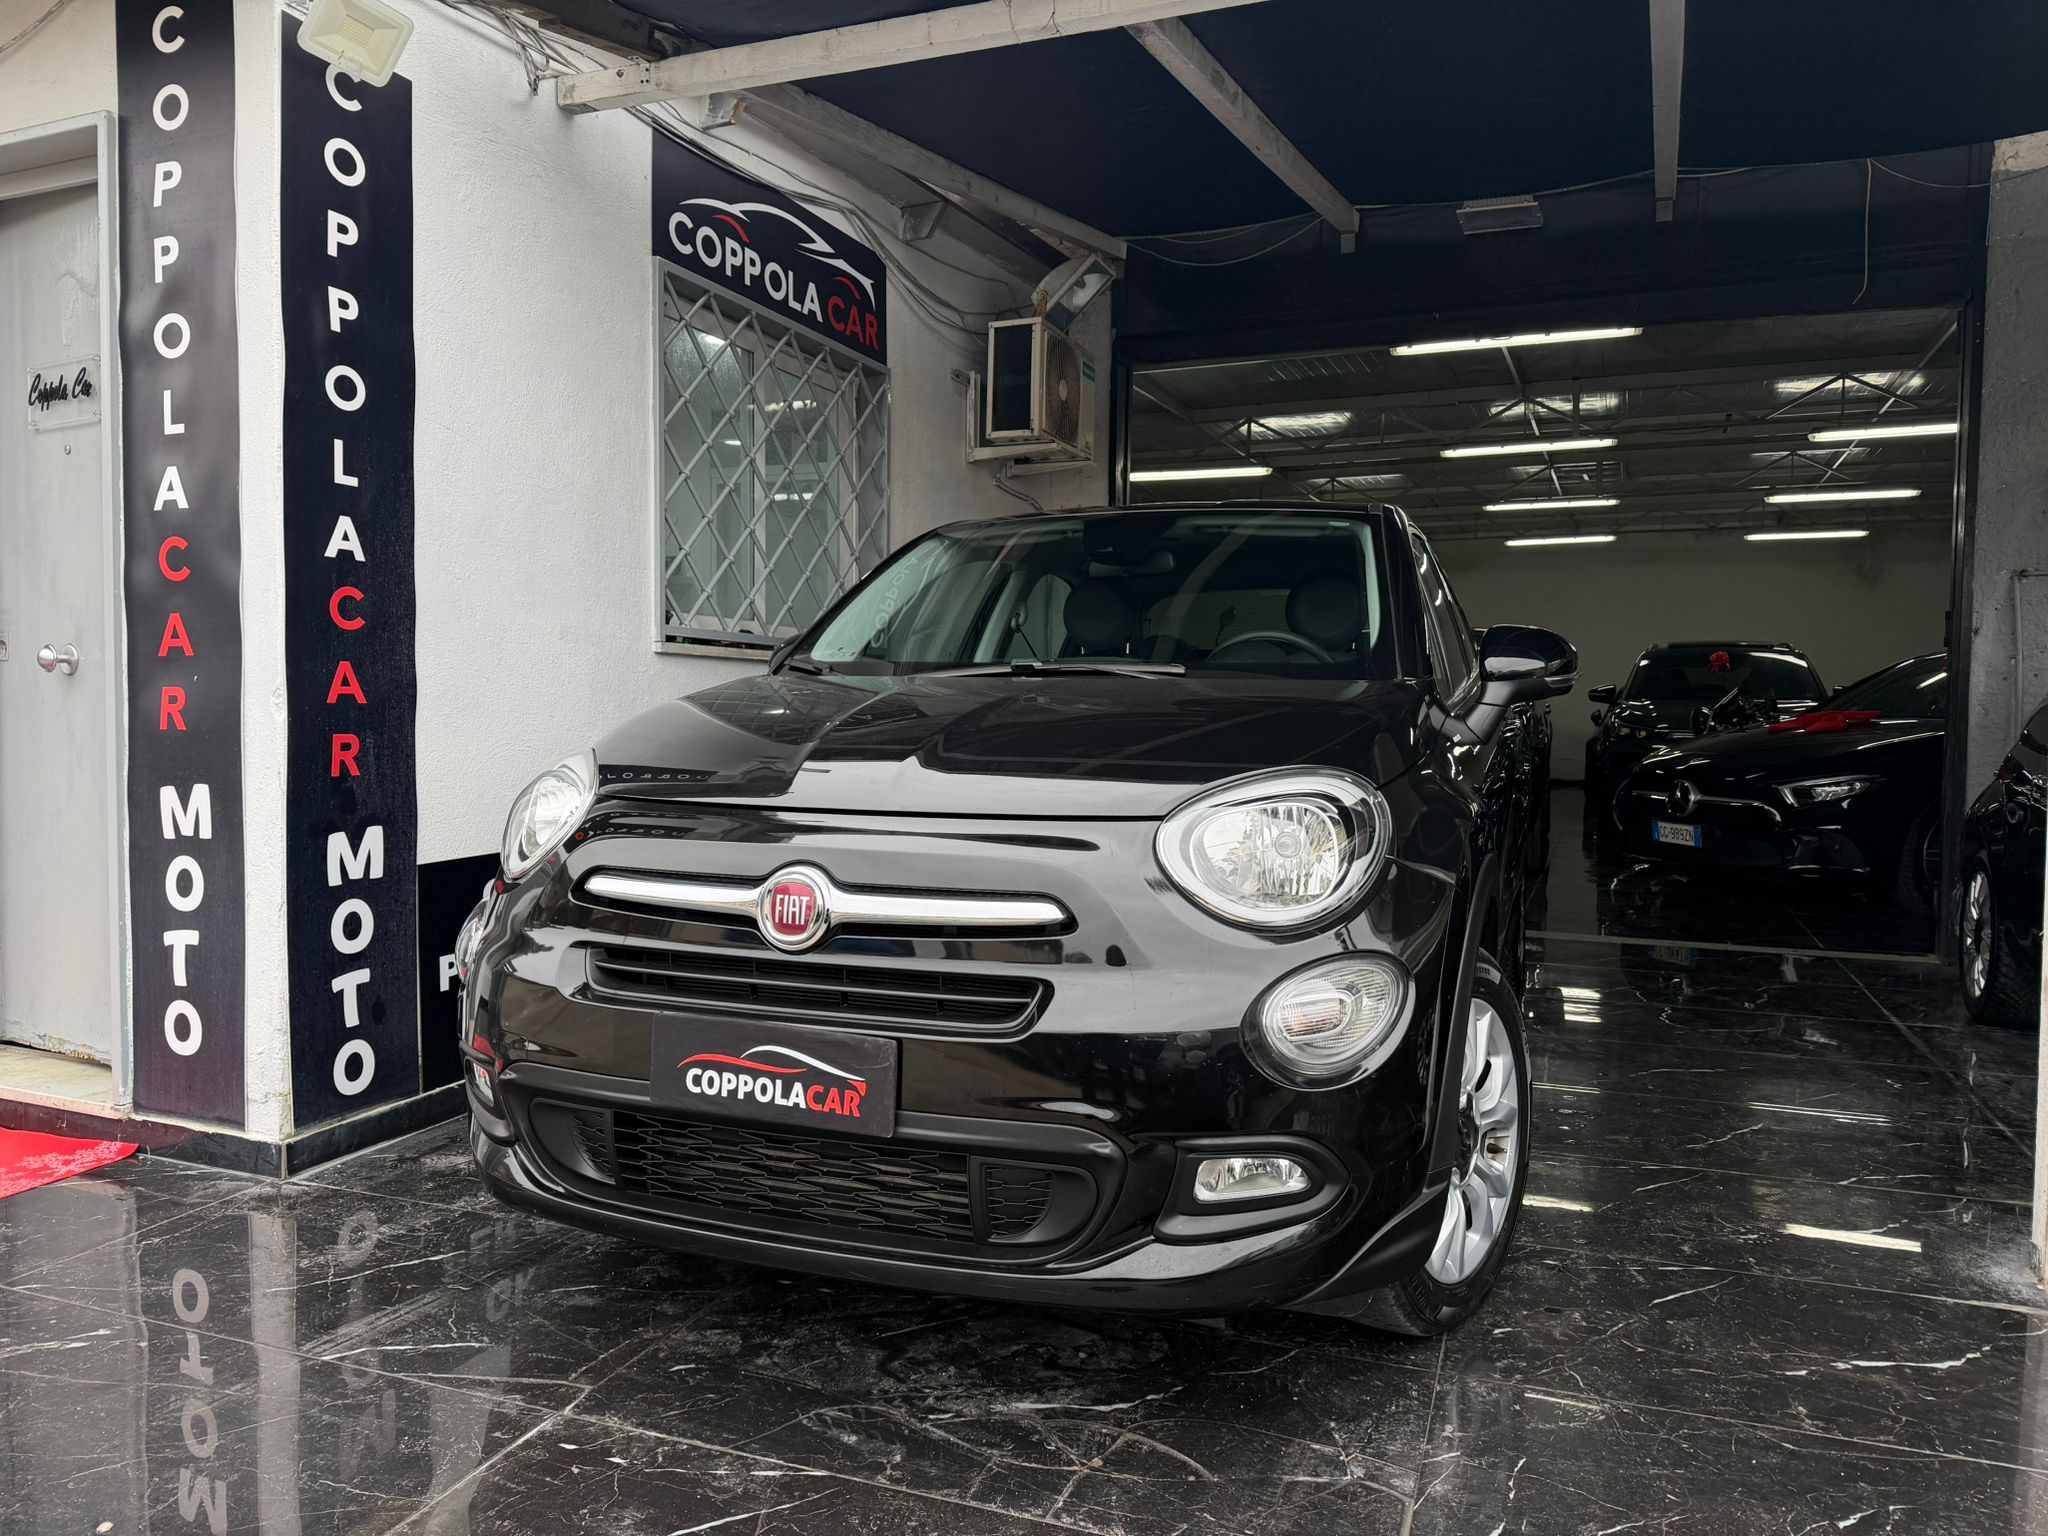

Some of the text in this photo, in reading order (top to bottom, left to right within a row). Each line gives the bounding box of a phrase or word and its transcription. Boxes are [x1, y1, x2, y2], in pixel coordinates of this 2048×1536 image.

[28, 373, 69, 412] Coppola
[160, 783, 213, 1056] MOTO
[326, 825, 385, 1096] MOTO
[775, 894, 810, 925] FIAT
